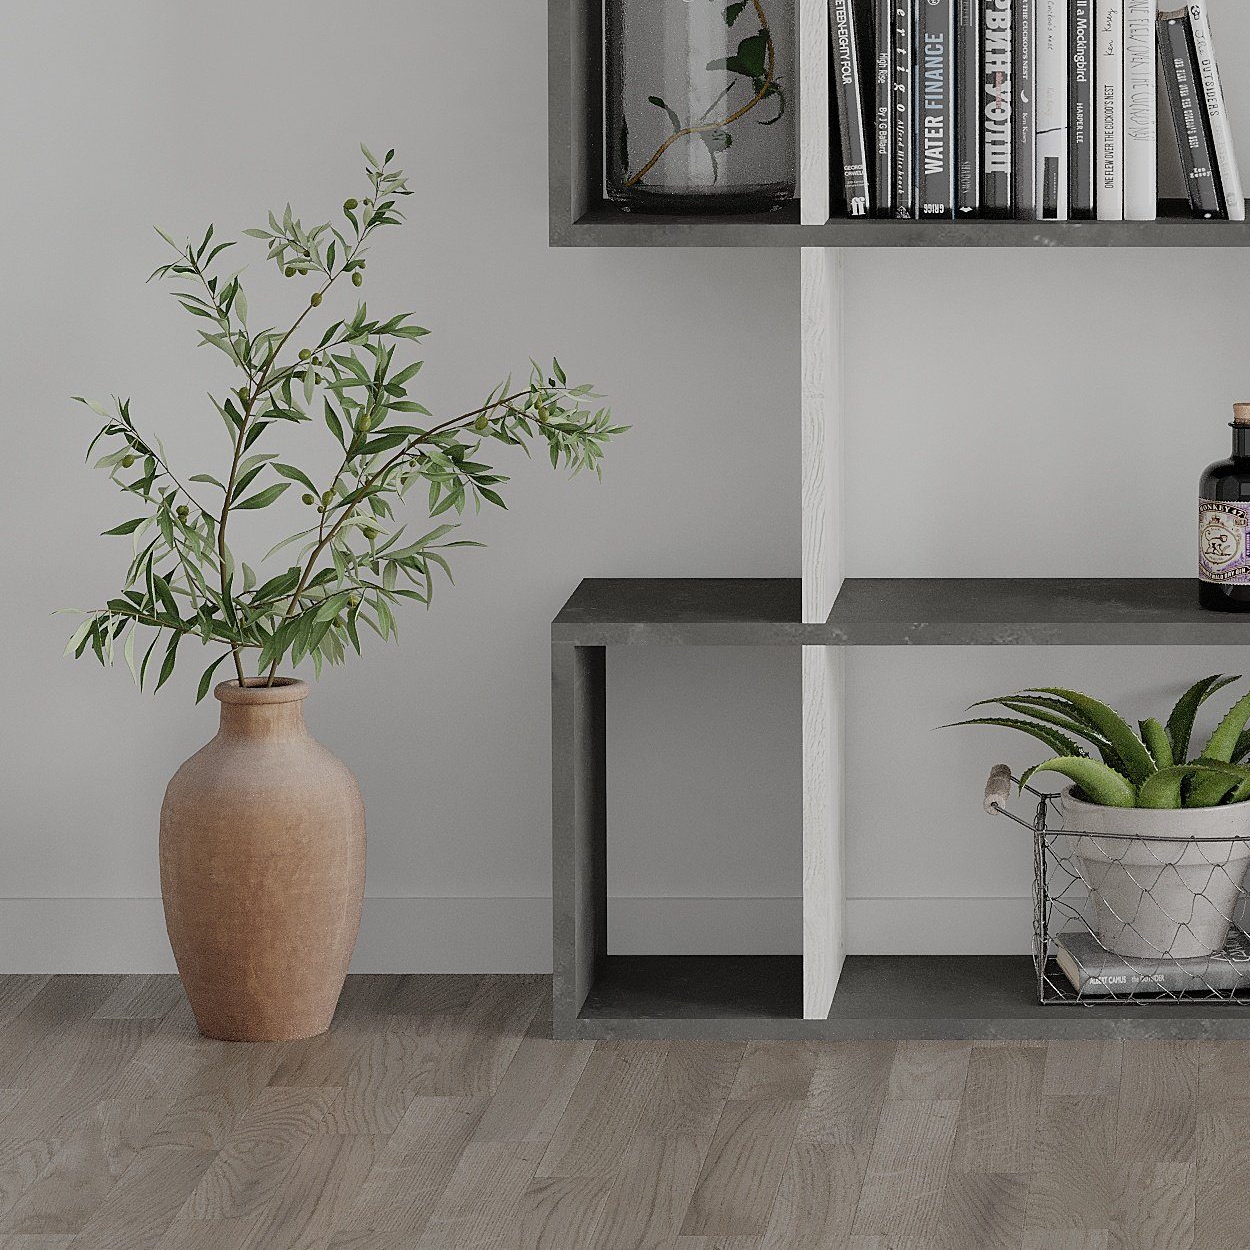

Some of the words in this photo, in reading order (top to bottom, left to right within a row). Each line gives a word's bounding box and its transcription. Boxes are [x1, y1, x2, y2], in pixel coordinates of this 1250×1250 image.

[1074, 18, 1087, 82] Mockingbird
[877, 52, 889, 68] High
[839, 61, 852, 85] FOUR
[877, 69, 888, 84] Rise
[924, 33, 943, 109] FINANCE
[1104, 84, 1114, 100] NEST
[1200, 59, 1220, 117] OUTSIDERS
[877, 107, 888, 116] By
[1076, 102, 1084, 130] HARPER
[1104, 100, 1114, 130] CUCKOO'S
[985, 81, 1012, 174] УЭЛШ
[878, 131, 888, 155] Ballard
[1076, 132, 1084, 144] LEE
[1104, 131, 1114, 142] THE
[924, 116, 943, 175] WATER
[1104, 143, 1114, 159] OVER
[1104, 160, 1114, 176] FLEW
[1104, 177, 1114, 189] ONE
[1108, 975, 1127, 984] CAMUS
